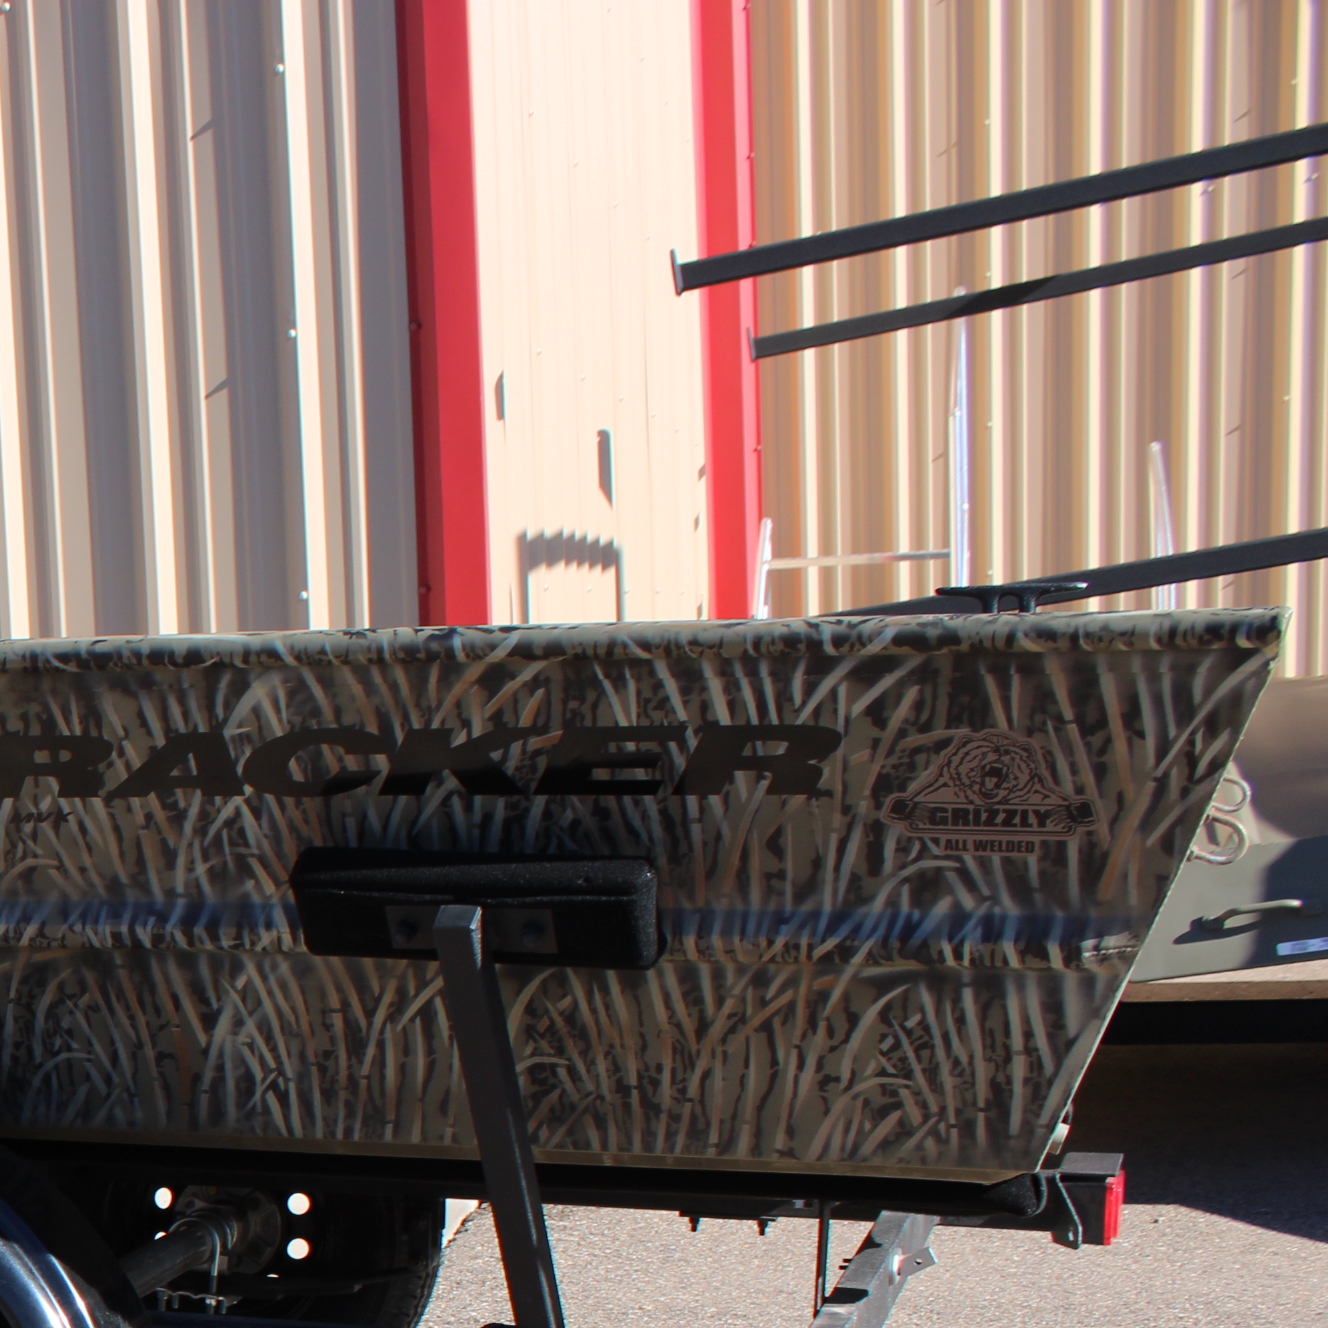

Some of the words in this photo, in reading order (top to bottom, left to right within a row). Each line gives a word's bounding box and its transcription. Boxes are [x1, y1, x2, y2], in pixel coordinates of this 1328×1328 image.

[928, 805, 1051, 829] GRIZZLY
[943, 838, 970, 853] ALL
[973, 839, 1036, 854] WELDED
